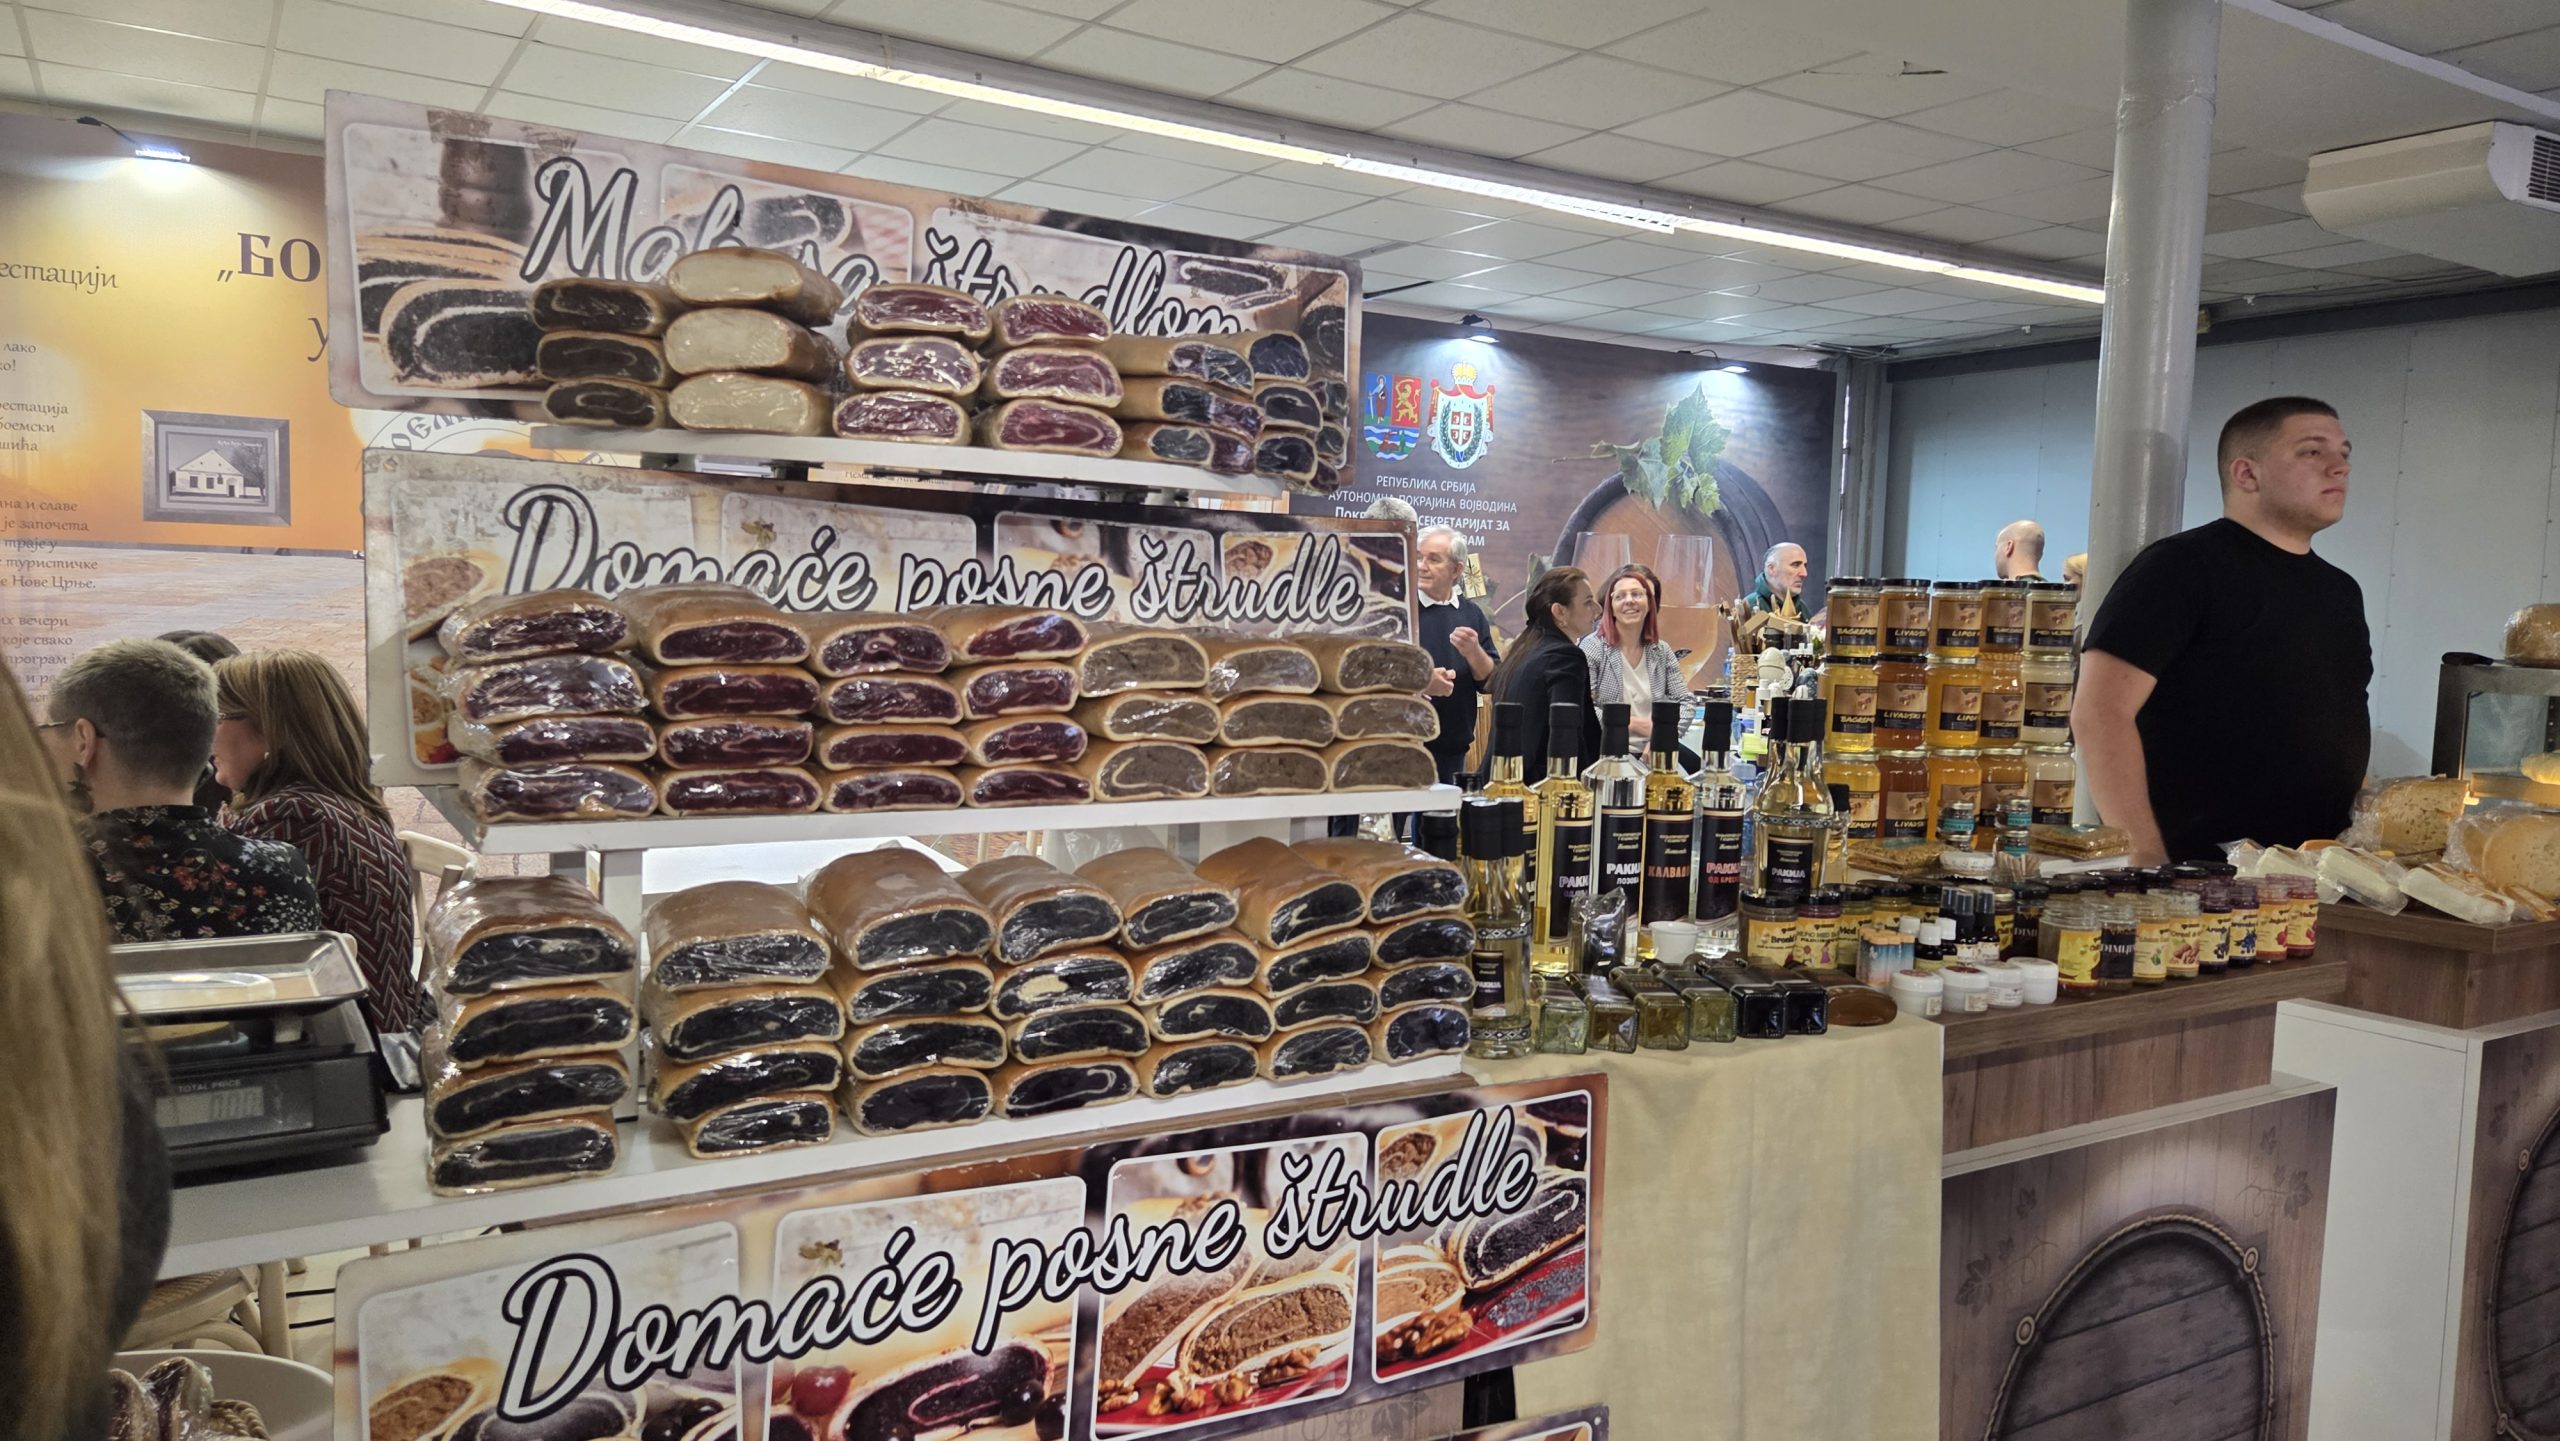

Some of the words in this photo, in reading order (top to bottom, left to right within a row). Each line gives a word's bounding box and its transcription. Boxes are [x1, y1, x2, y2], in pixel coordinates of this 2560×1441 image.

[4, 343, 37, 354] лако
[1376, 475, 1438, 491] РЕПУБЛИКА
[1440, 480, 1477, 496] СРБИЈА
[26, 501, 35, 510] и
[39, 502, 79, 512] славе
[1459, 498, 1518, 514] ВОЈВОДИНА
[19, 519, 90, 532] започета
[1418, 514, 1494, 533] СЕКРЕТАРИЈАТ
[1495, 520, 1511, 531] ЗА
[4, 538, 46, 554] траје
[46, 541, 58, 554] у
[6, 558, 99, 572] туристичке
[12, 575, 49, 588] Нове
[52, 576, 97, 592] Црње.
[1130, 532, 1369, 625] štrudle
[18, 617, 69, 631] вечери
[33, 636, 73, 646] свако
[179, 1084, 209, 1092] TOTAL
[212, 1080, 241, 1089] PRICE
[496, 1225, 963, 1423] Domaće
[972, 1199, 1247, 1357] posne
[1264, 1105, 1538, 1258] štrudle
